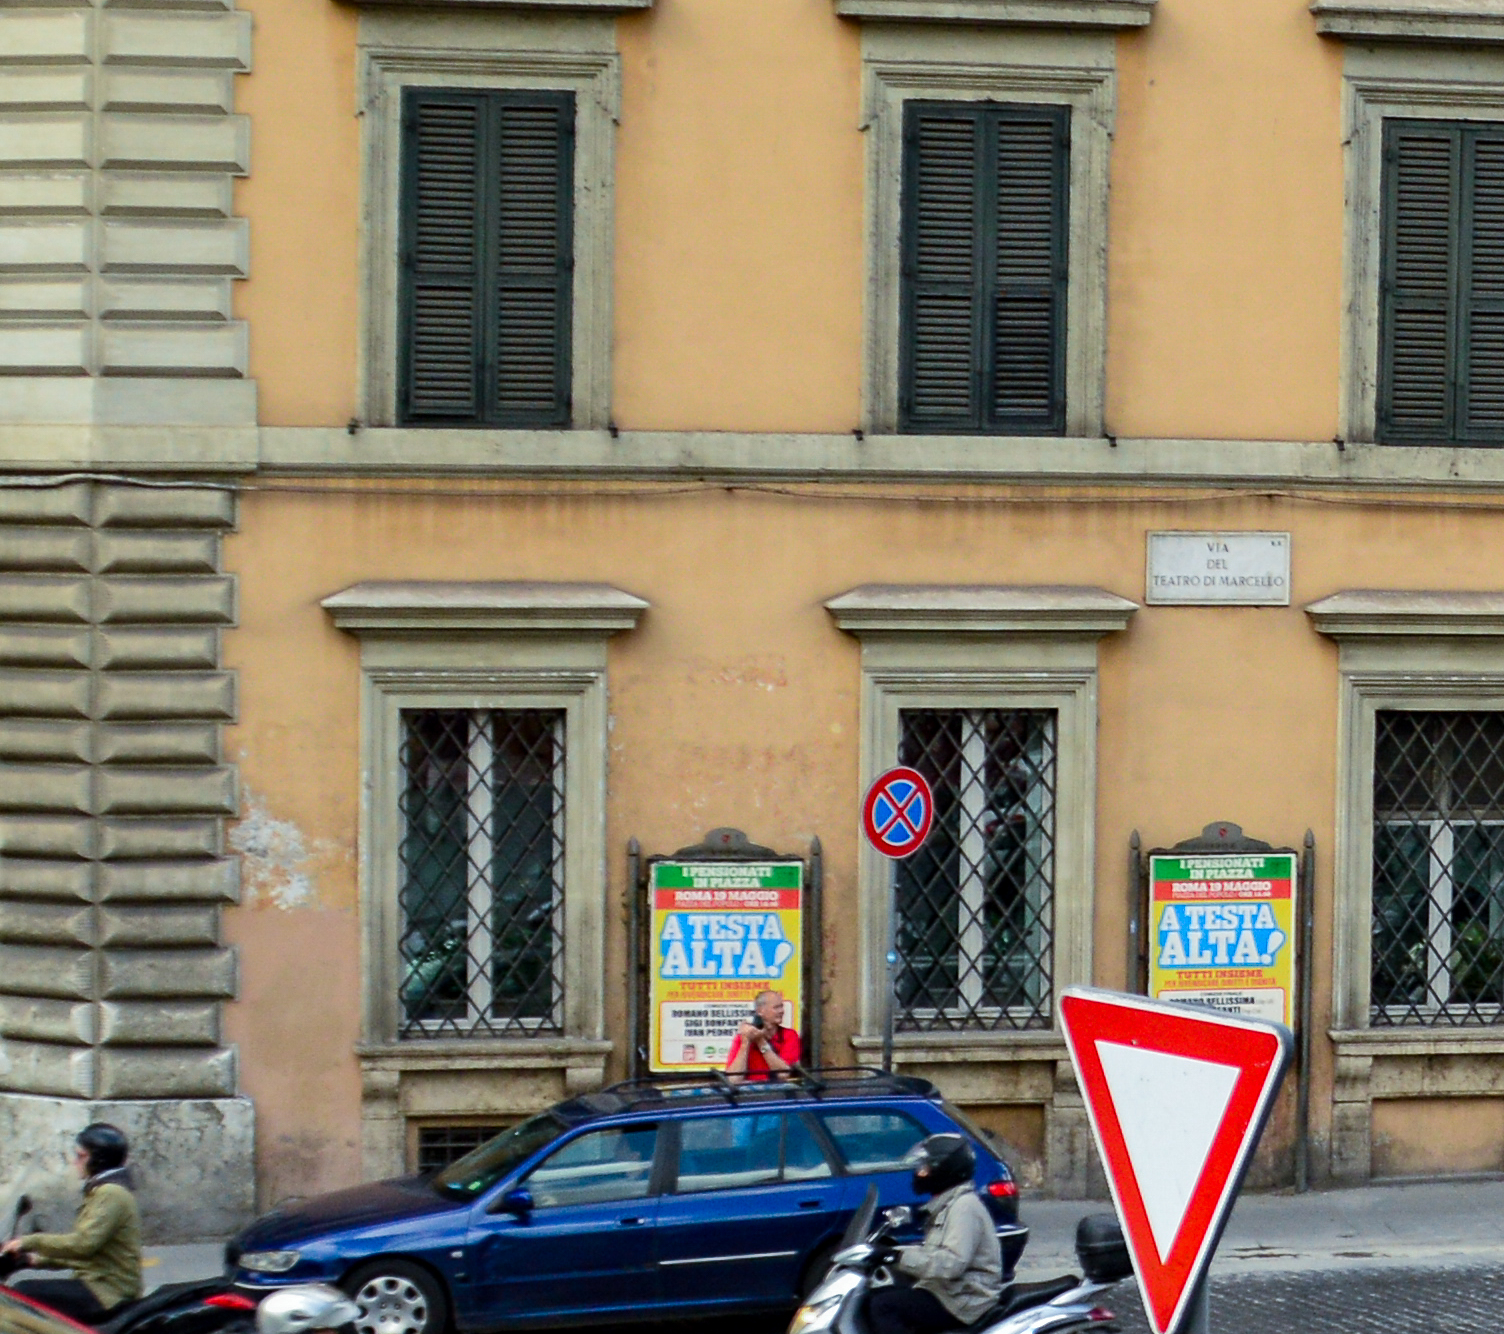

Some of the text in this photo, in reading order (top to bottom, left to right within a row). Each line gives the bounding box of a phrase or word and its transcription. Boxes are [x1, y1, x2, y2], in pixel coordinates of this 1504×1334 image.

[1207, 542, 1229, 553] VIA
[1206, 559, 1228, 570] DEL
[1154, 576, 1284, 587] TEATRO DI MARCELLO
[1188, 858, 1264, 868] PENSIONATI
[689, 867, 772, 877] PENSIONATI
[1190, 869, 1254, 879] IN PIAZZA
[709, 877, 761, 887] PIAZZA
[1172, 881, 1272, 893] ROMA 19 MAGGIO
[675, 890, 779, 901] ROMA 19 MAGGIO
[1160, 903, 1275, 931] A TESTA
[662, 913, 783, 940] A TESTA
[1159, 930, 1285, 965] ALTA!
[661, 940, 794, 977] ALTA!
[1176, 970, 1263, 979] TUTTI INSIEME
[680, 981, 771, 990] TUTTI INSIEME
[1206, 997, 1255, 1005] BELLISSIMA
[671, 1010, 708, 1018] ROMANO
[684, 1019, 703, 1027] GIGI
